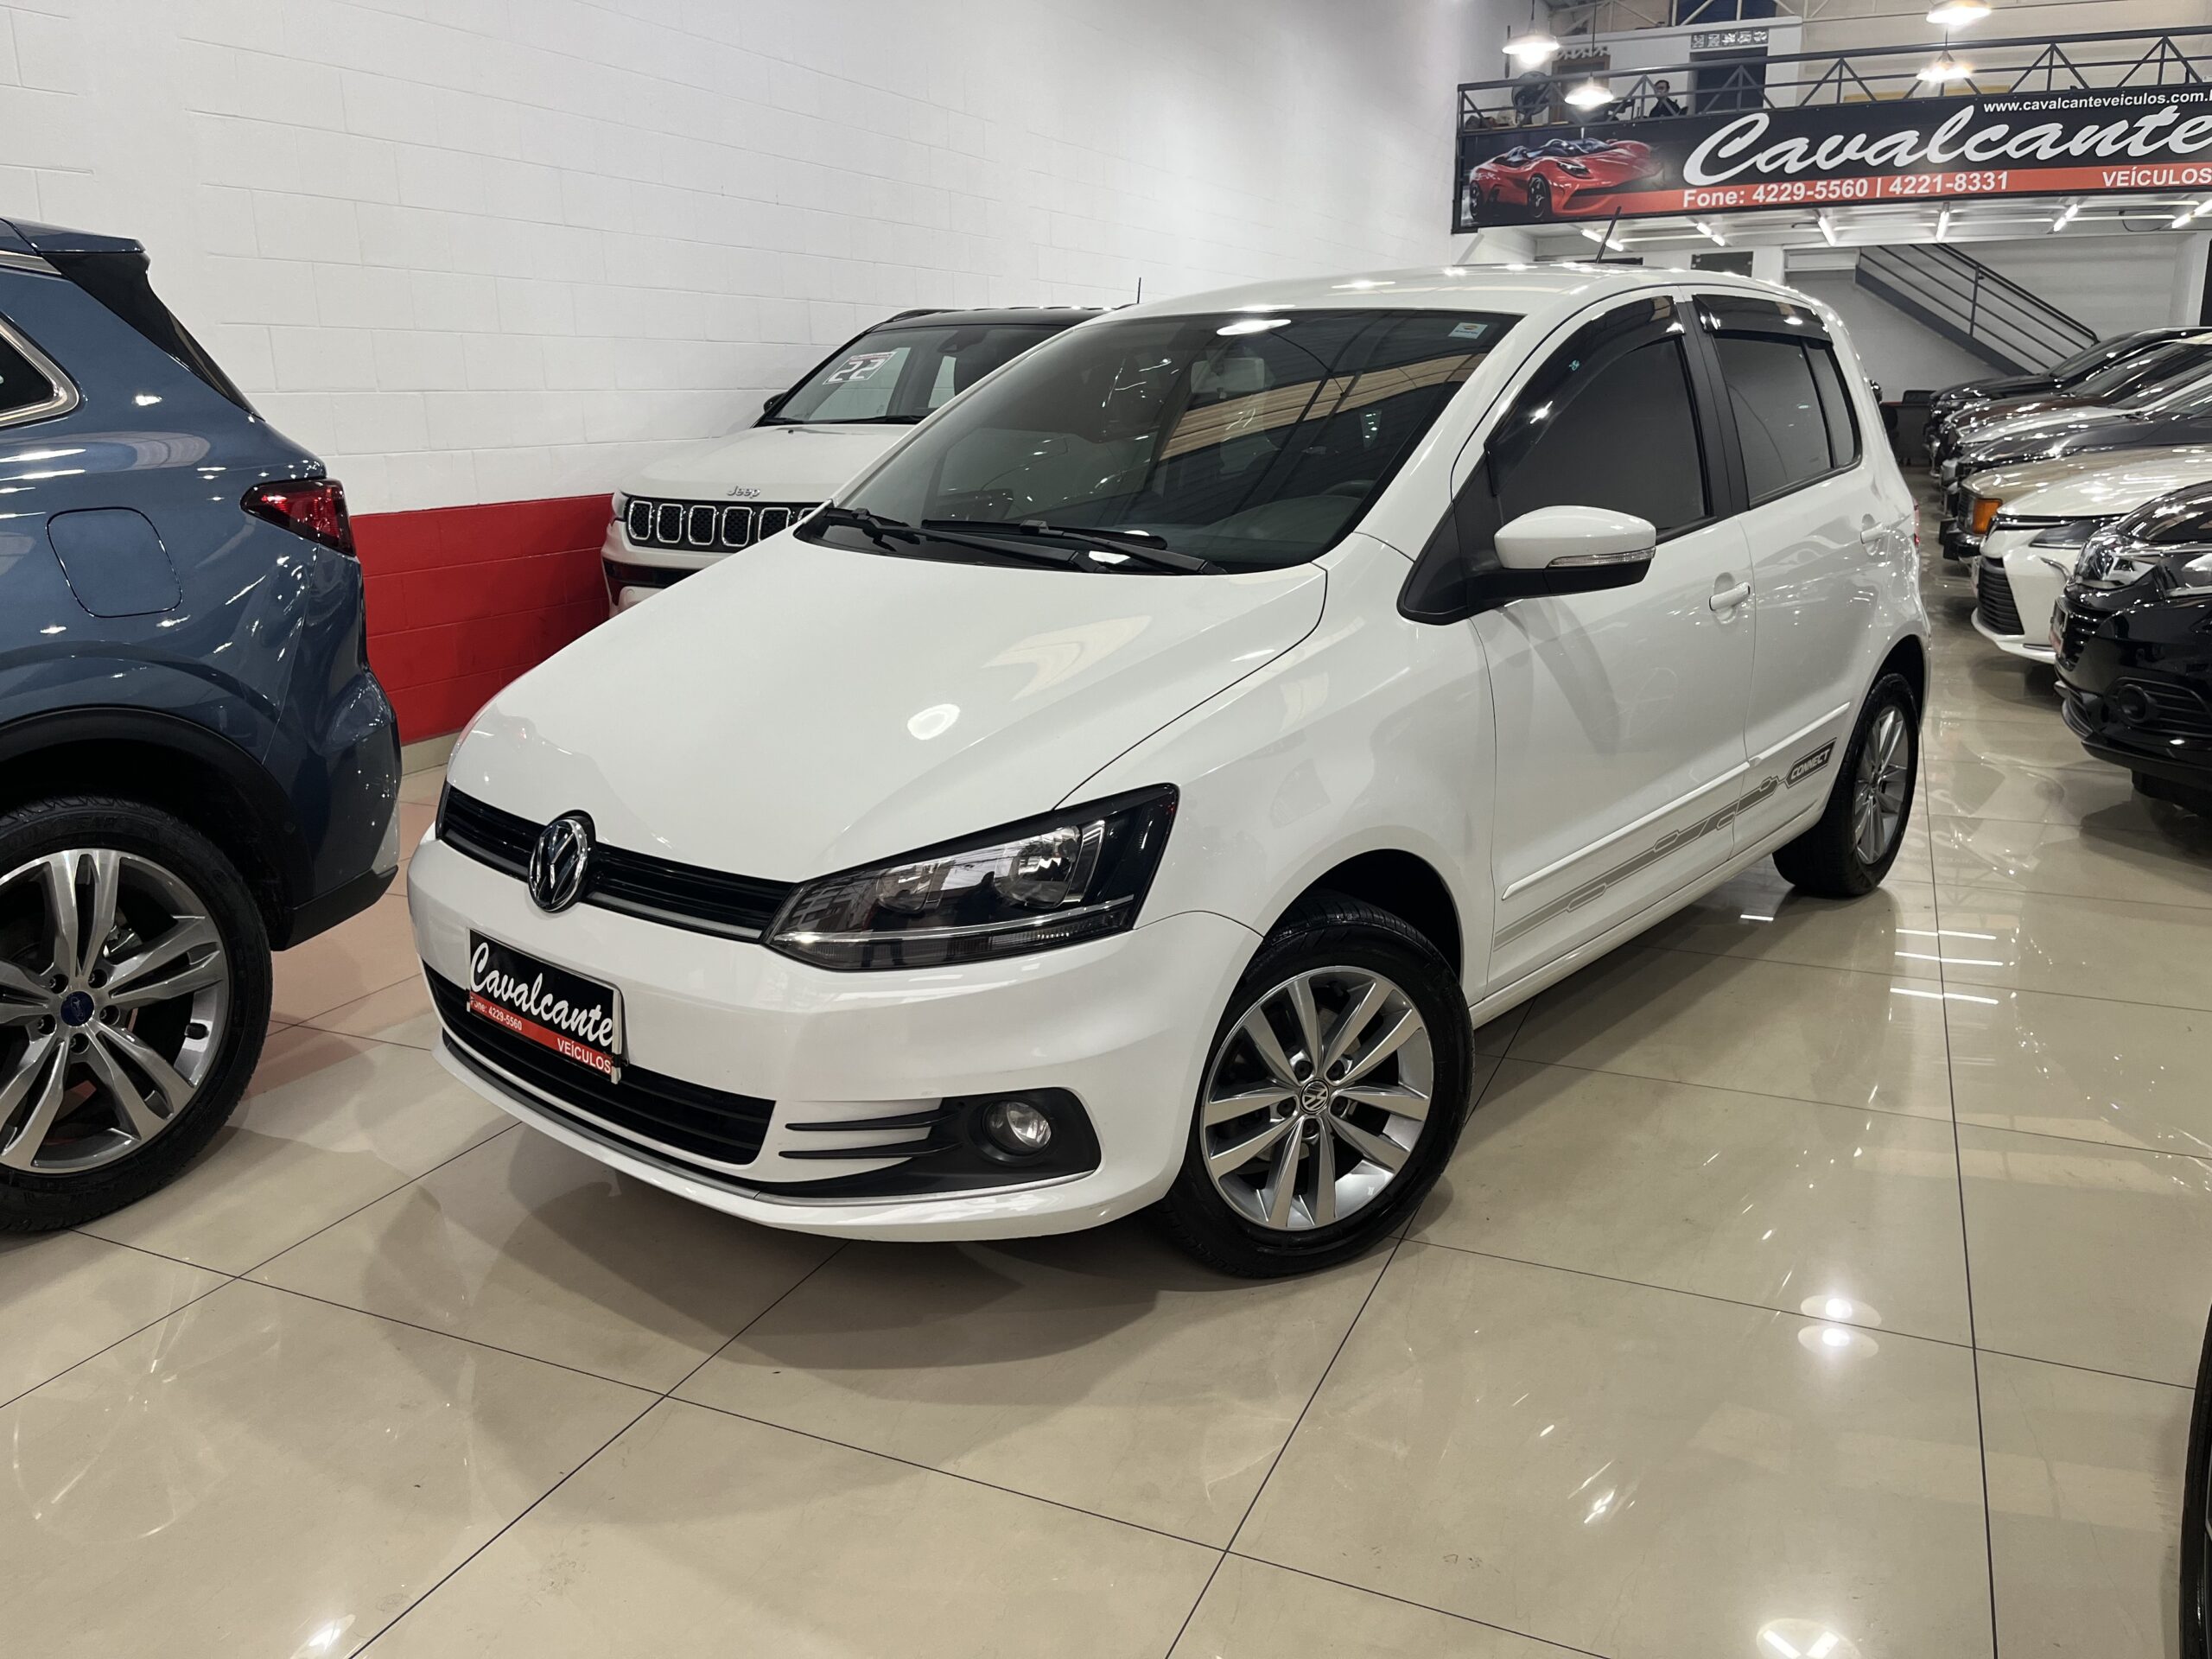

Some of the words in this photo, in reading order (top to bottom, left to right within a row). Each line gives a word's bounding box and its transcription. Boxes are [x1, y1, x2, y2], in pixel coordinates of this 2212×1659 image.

[1682, 105, 2212, 186] Cavalcante
[1682, 188, 1745, 208] Fone:
[1752, 178, 1868, 204] 4229-5560
[1888, 171, 2008, 195] 4221-8331
[2102, 166, 2212, 188] VEÍCULOS
[727, 485, 761, 499] Jeep
[1791, 748, 1830, 779] CONNECT
[469, 942, 613, 1047] Cavalcante
[488, 1006, 523, 1031] 4229-5560
[556, 1038, 612, 1075] VEÍCULOS
